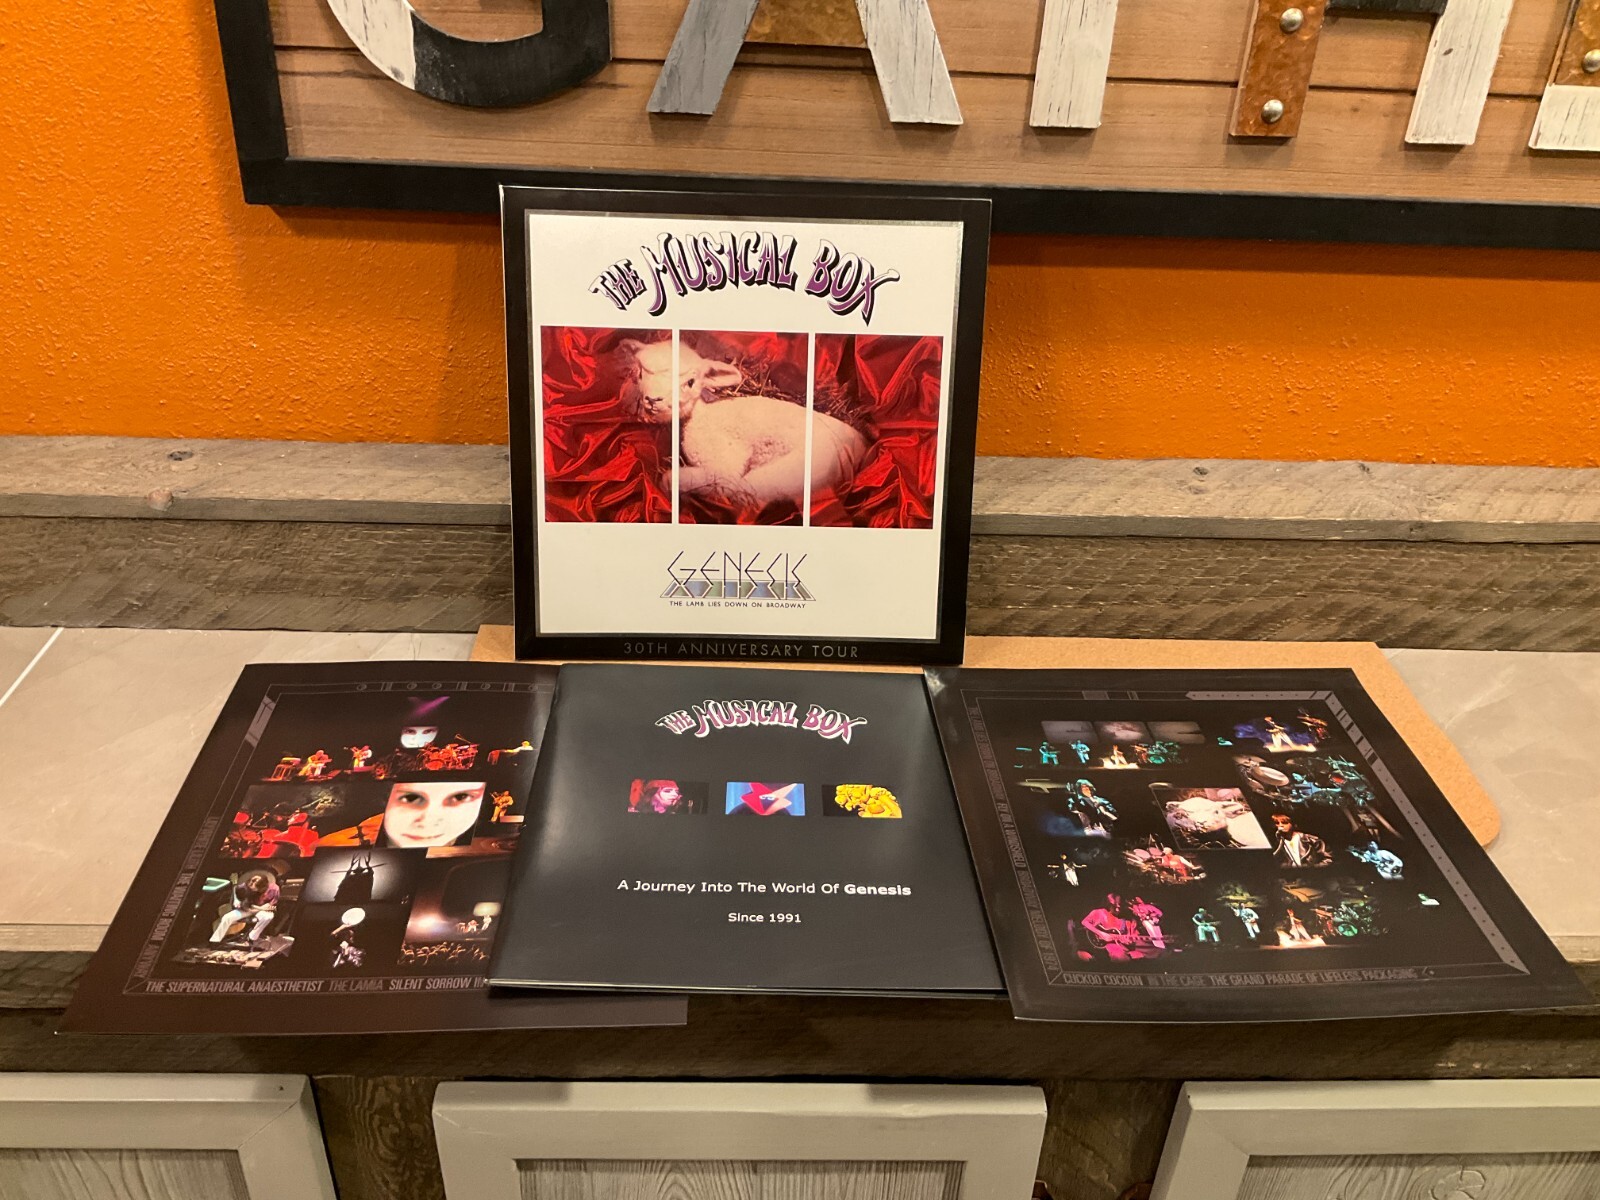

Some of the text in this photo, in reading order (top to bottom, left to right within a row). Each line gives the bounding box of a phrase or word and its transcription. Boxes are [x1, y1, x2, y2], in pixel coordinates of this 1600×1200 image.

[588, 230, 901, 327] THE MUSICAL BOX
[667, 550, 808, 588] GENESIS
[623, 642, 859, 659] 30TH ANNIVERSARY TOUR
[655, 699, 868, 744] THE MUSICAL BOX
[617, 880, 912, 896] A Journey Into The World Of Genesis
[728, 912, 802, 923] Since 1991
[145, 980, 325, 993] THE SUPERNATURAL ANAESTHETIST
[329, 979, 384, 992] THE LAMIA
[388, 978, 424, 991] SILENT
[426, 977, 472, 990] SORROW
[1063, 973, 1144, 986] CUCKOO COCOON
[1209, 975, 1229, 987] THE
[1229, 974, 1265, 986] GRAND
[1265, 973, 1305, 985] PARADE
[1305, 972, 1318, 984] OF
